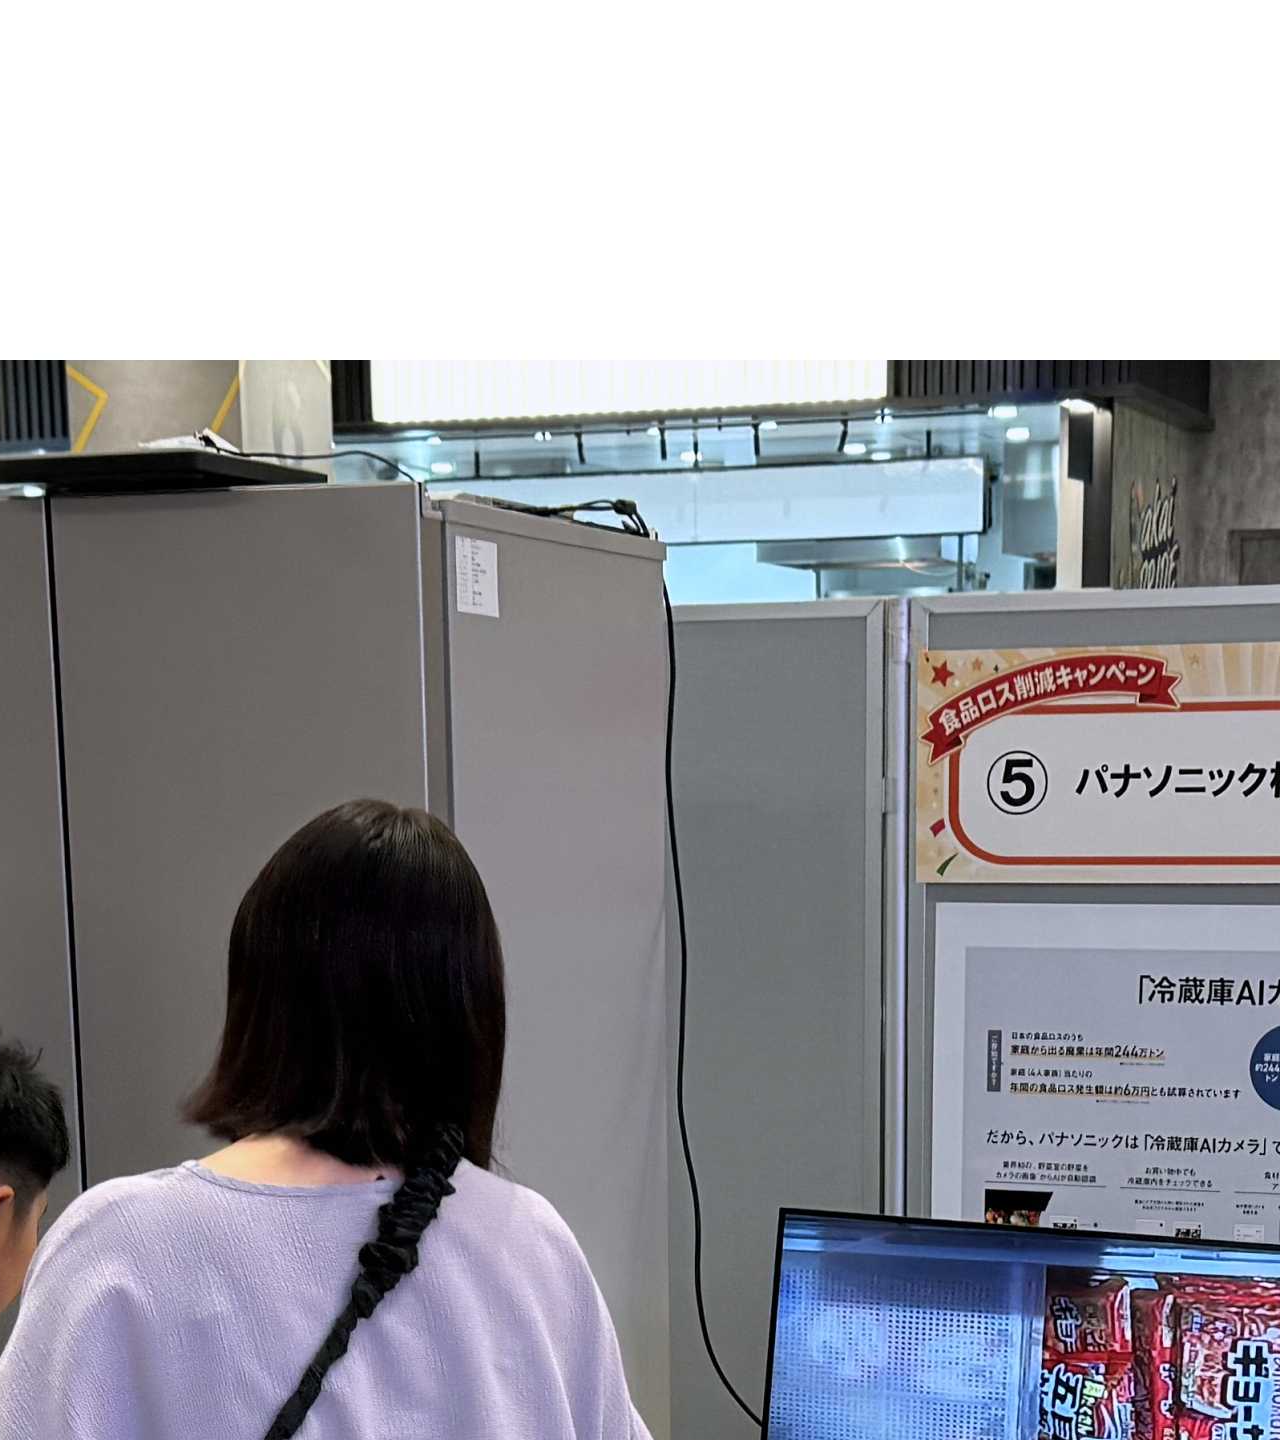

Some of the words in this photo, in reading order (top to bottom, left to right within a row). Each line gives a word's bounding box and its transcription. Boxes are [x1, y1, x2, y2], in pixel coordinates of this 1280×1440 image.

[938, 661, 1157, 736] 食品ロス削減キャンペーン
